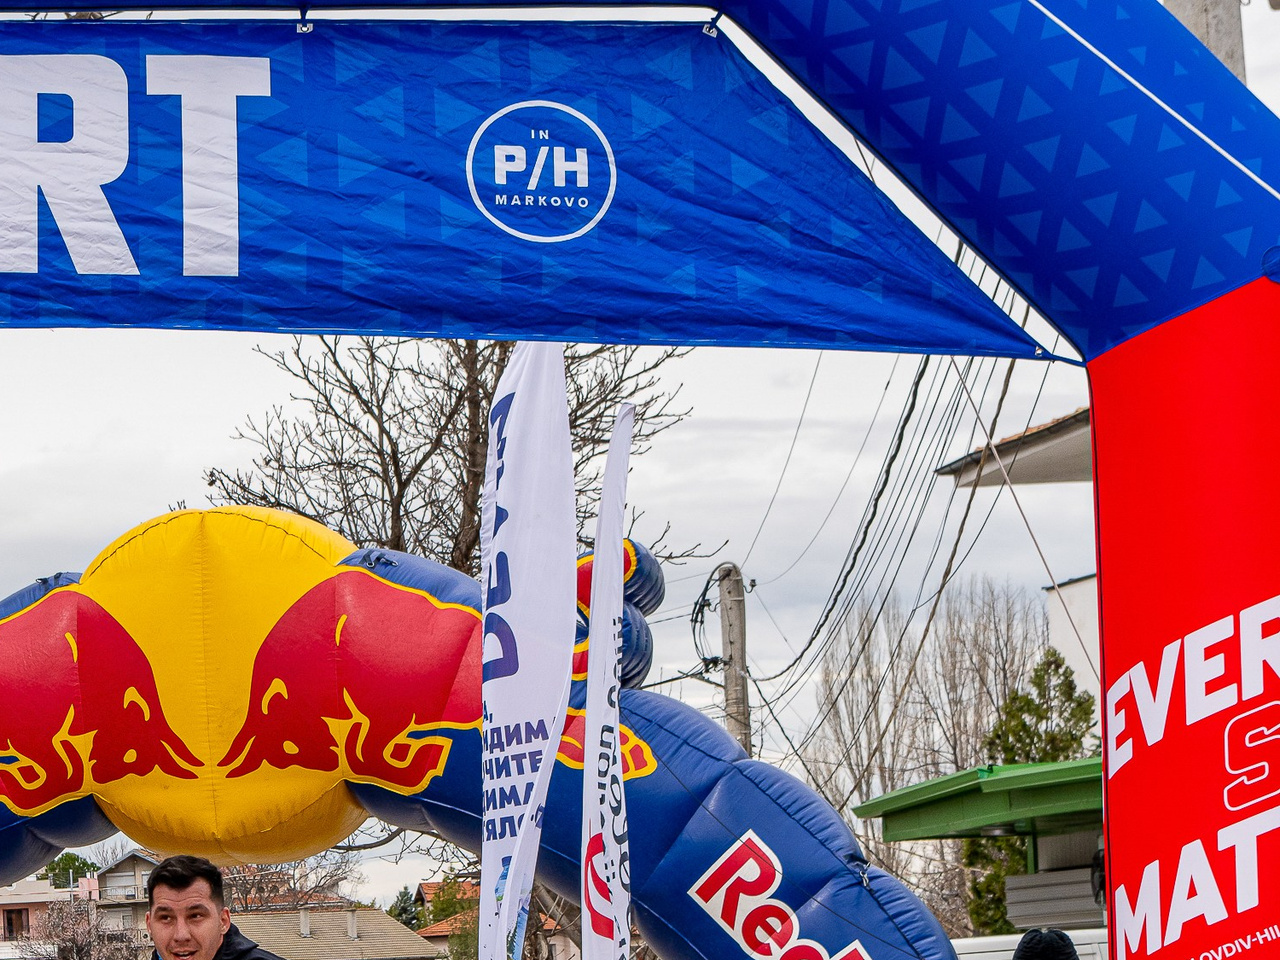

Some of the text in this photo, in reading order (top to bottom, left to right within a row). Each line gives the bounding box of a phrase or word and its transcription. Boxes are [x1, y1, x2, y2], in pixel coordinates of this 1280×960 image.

[530, 129, 549, 140] IN
[494, 144, 589, 191] P/H
[494, 194, 589, 208] MARKOVO
[482, 749, 543, 781] ЧИТЕ
